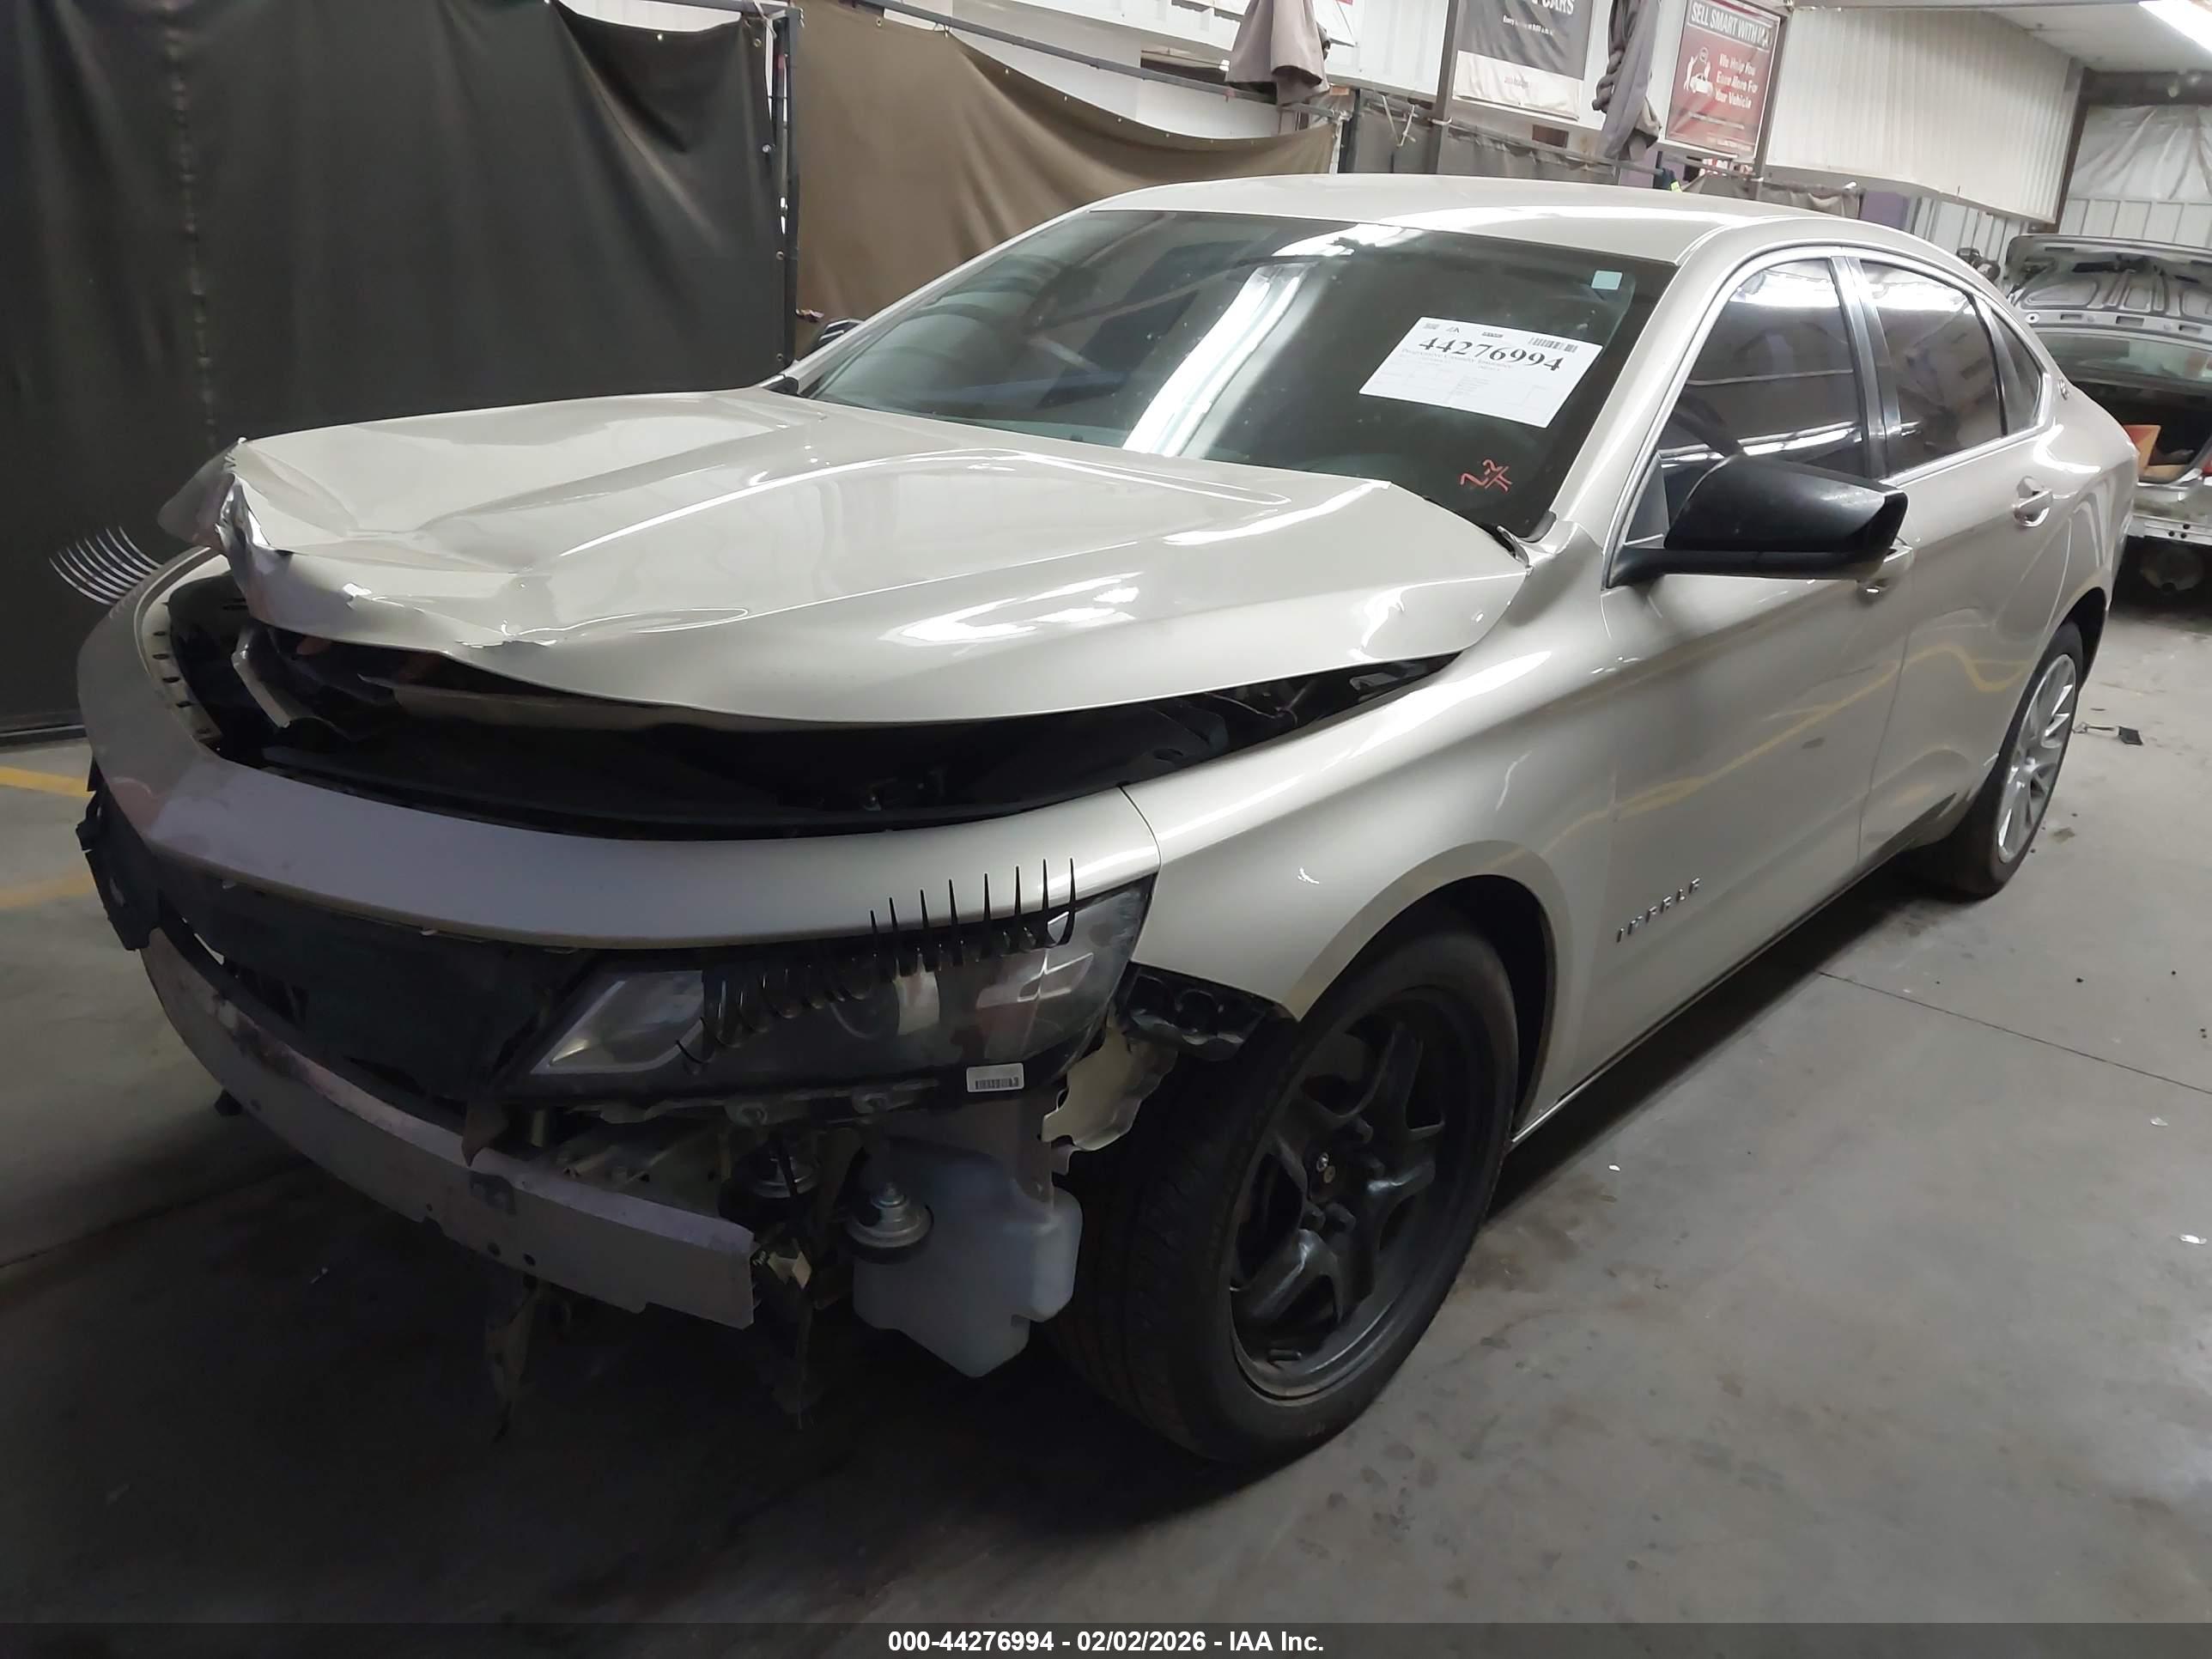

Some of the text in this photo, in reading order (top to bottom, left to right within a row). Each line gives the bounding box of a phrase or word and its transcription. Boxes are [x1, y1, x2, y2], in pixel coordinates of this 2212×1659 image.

[1691, 2, 1709, 26] SELL
[1710, 9, 1738, 35] SMART
[1738, 19, 1759, 43] WITH
[1419, 337, 1565, 371] 44276994
